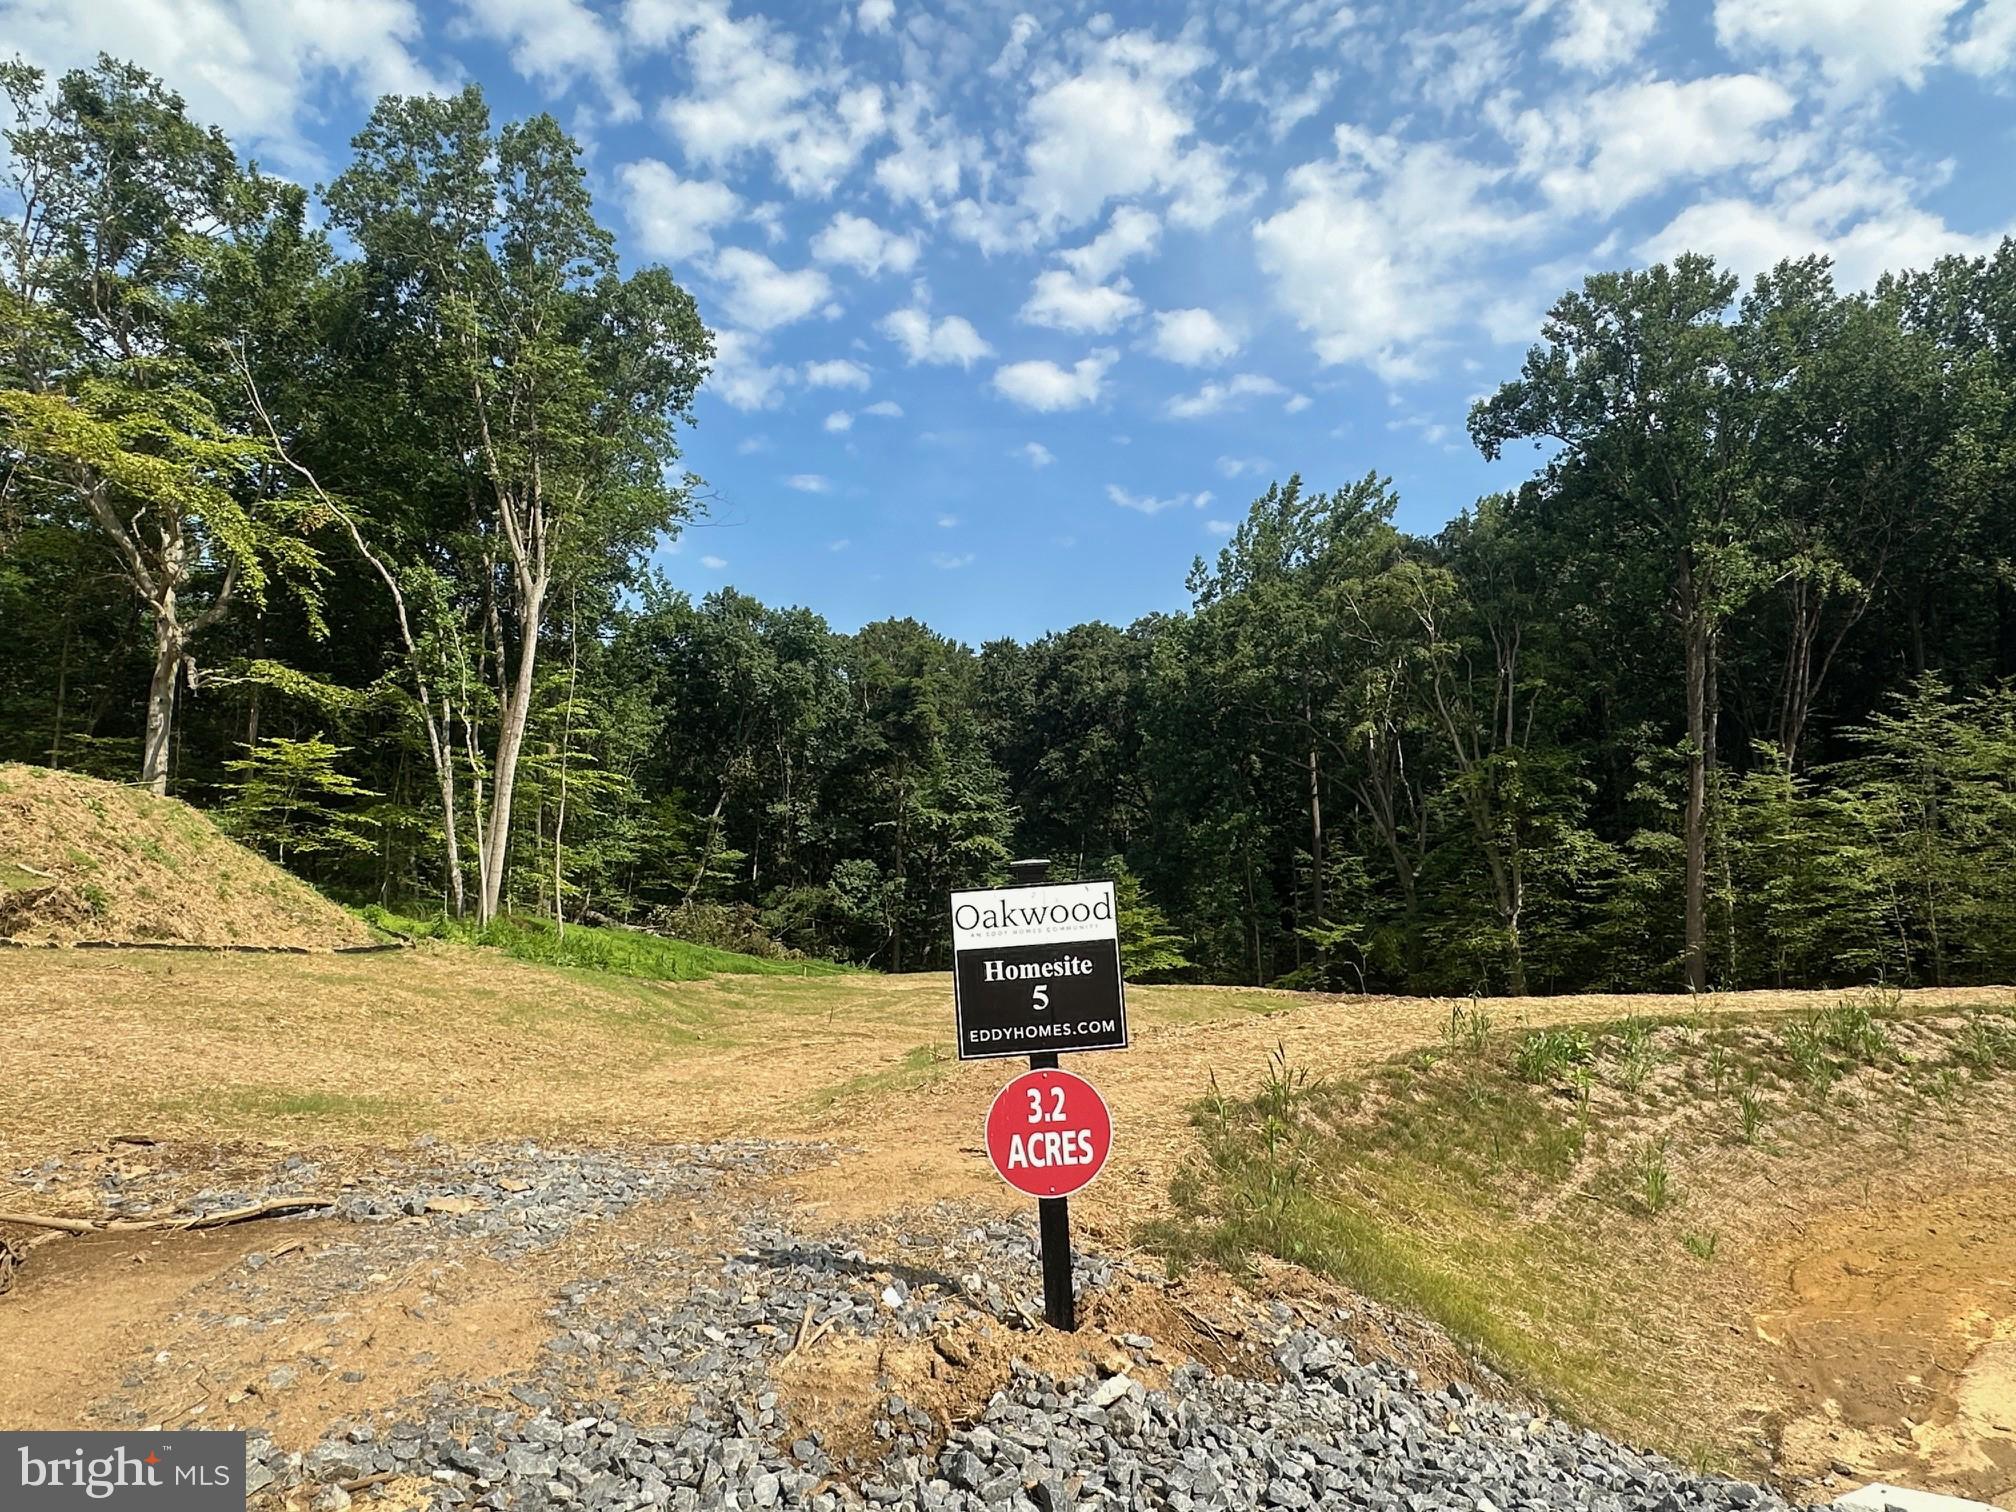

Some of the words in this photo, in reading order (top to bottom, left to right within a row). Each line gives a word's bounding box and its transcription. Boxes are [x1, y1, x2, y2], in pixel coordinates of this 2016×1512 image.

[955, 892, 1112, 930] Oakwood
[1046, 924, 1099, 933] COMMUNITY
[984, 955, 1093, 982] Homesite
[1032, 984, 1050, 1010] 5
[970, 1020, 1115, 1043] EDDYHOMES.COM
[1026, 1086, 1067, 1124] 3.2
[1007, 1129, 1094, 1170] ACRES
